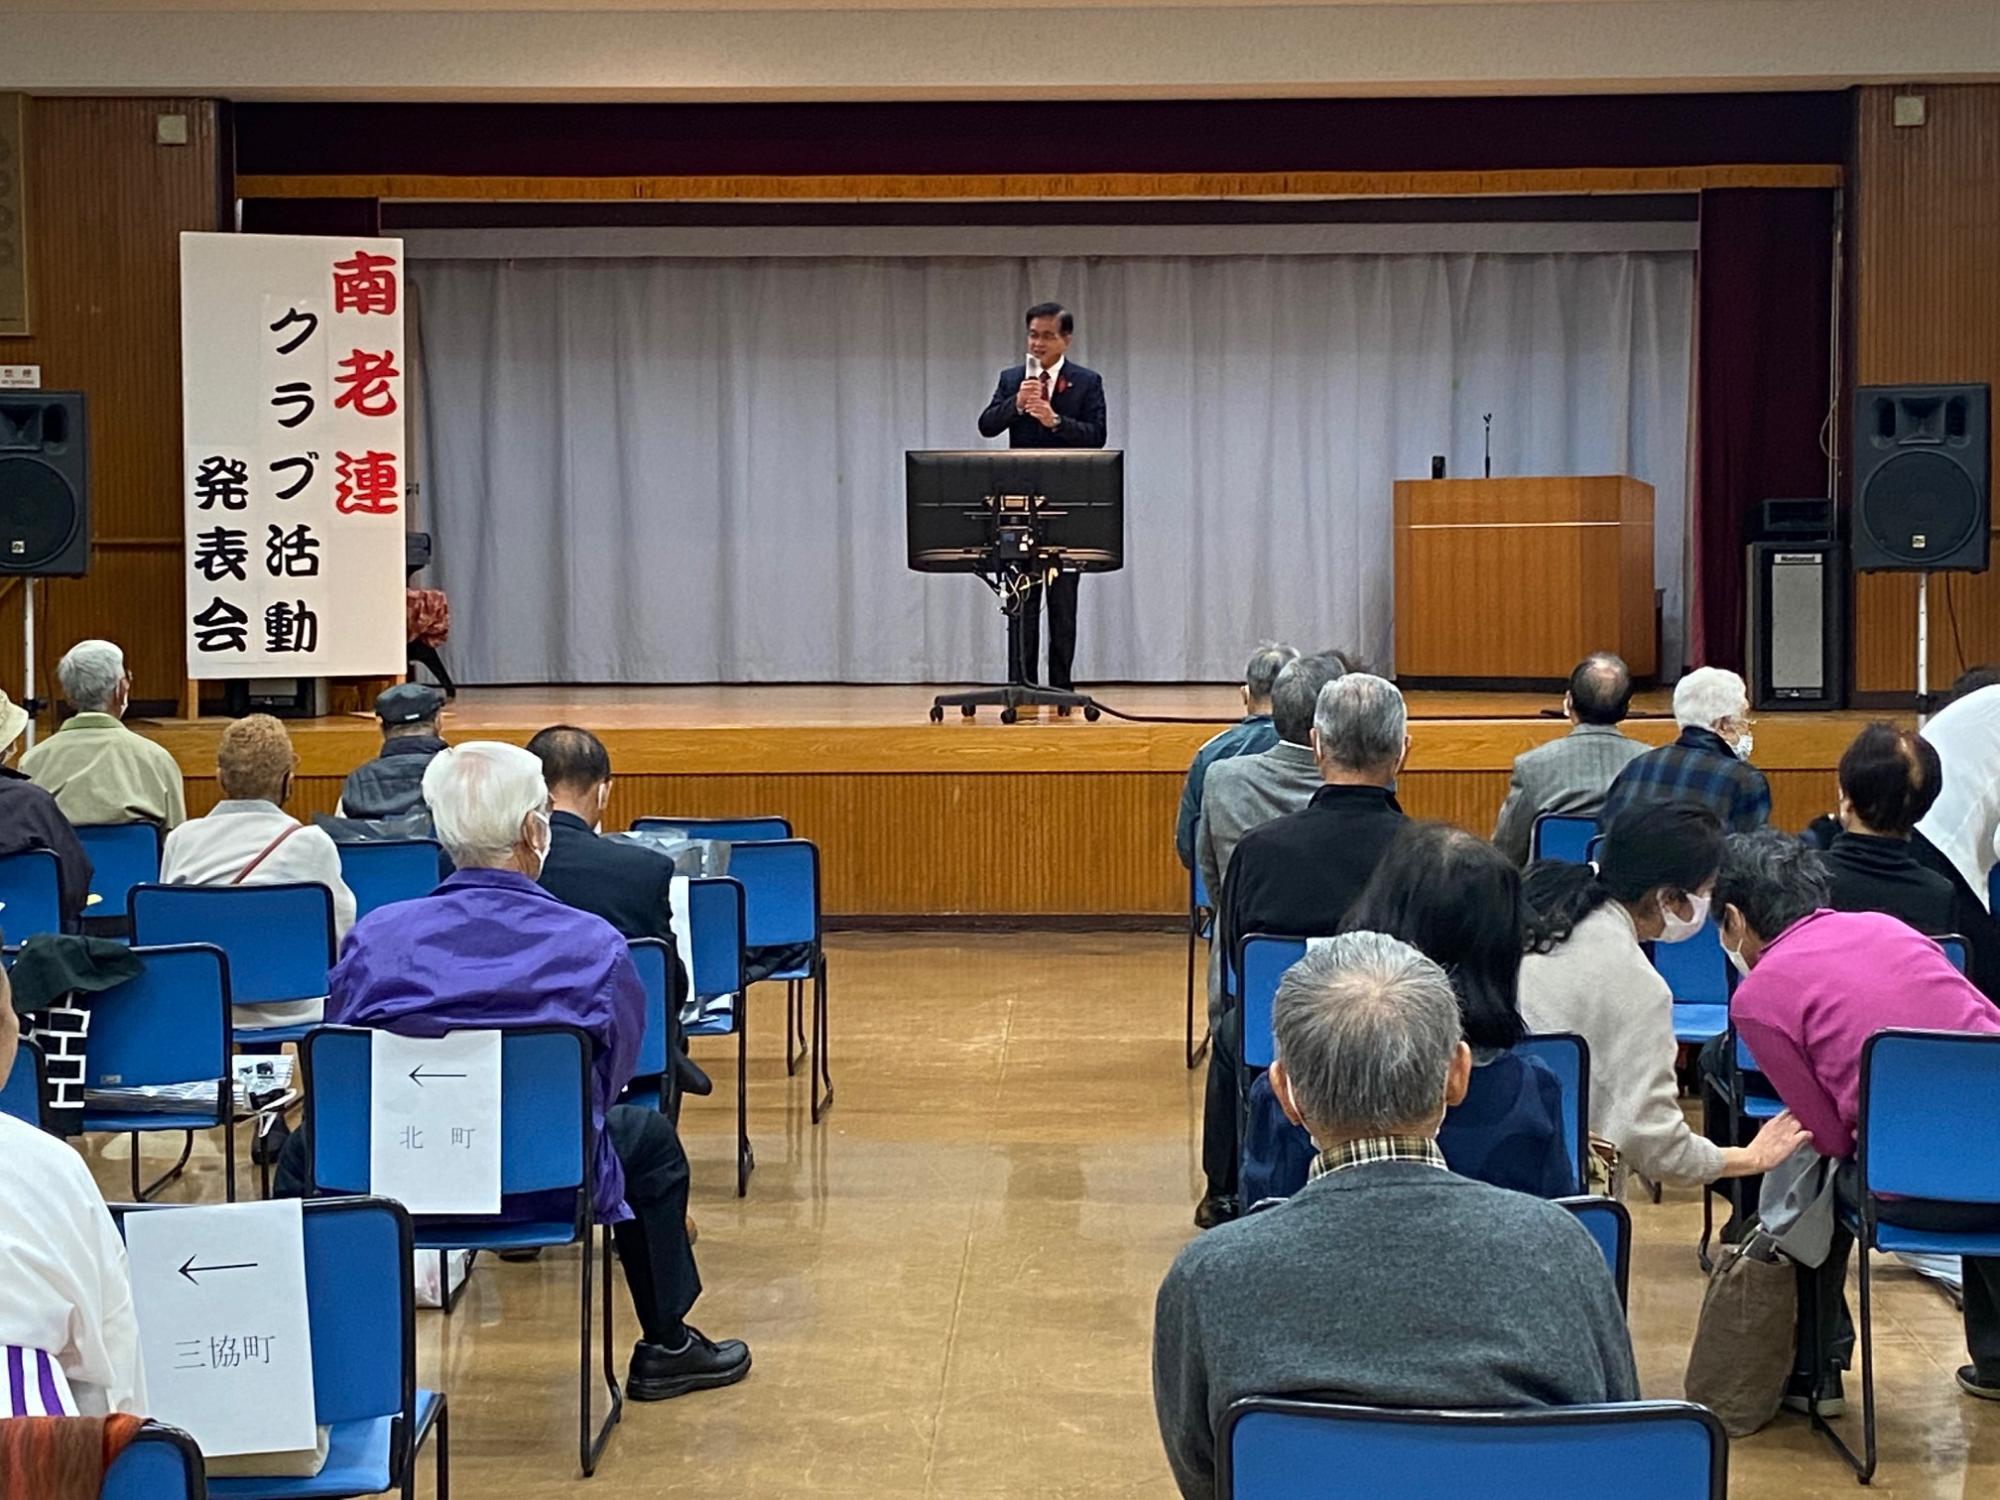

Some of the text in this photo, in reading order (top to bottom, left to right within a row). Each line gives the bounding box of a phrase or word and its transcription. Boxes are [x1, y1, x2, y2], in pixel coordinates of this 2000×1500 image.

[264, 307, 320, 653] クラブ活動
[332, 250, 400, 516] 南老連
[193, 455, 249, 653] 発表会
[173, 1334, 276, 1370] 三協町
